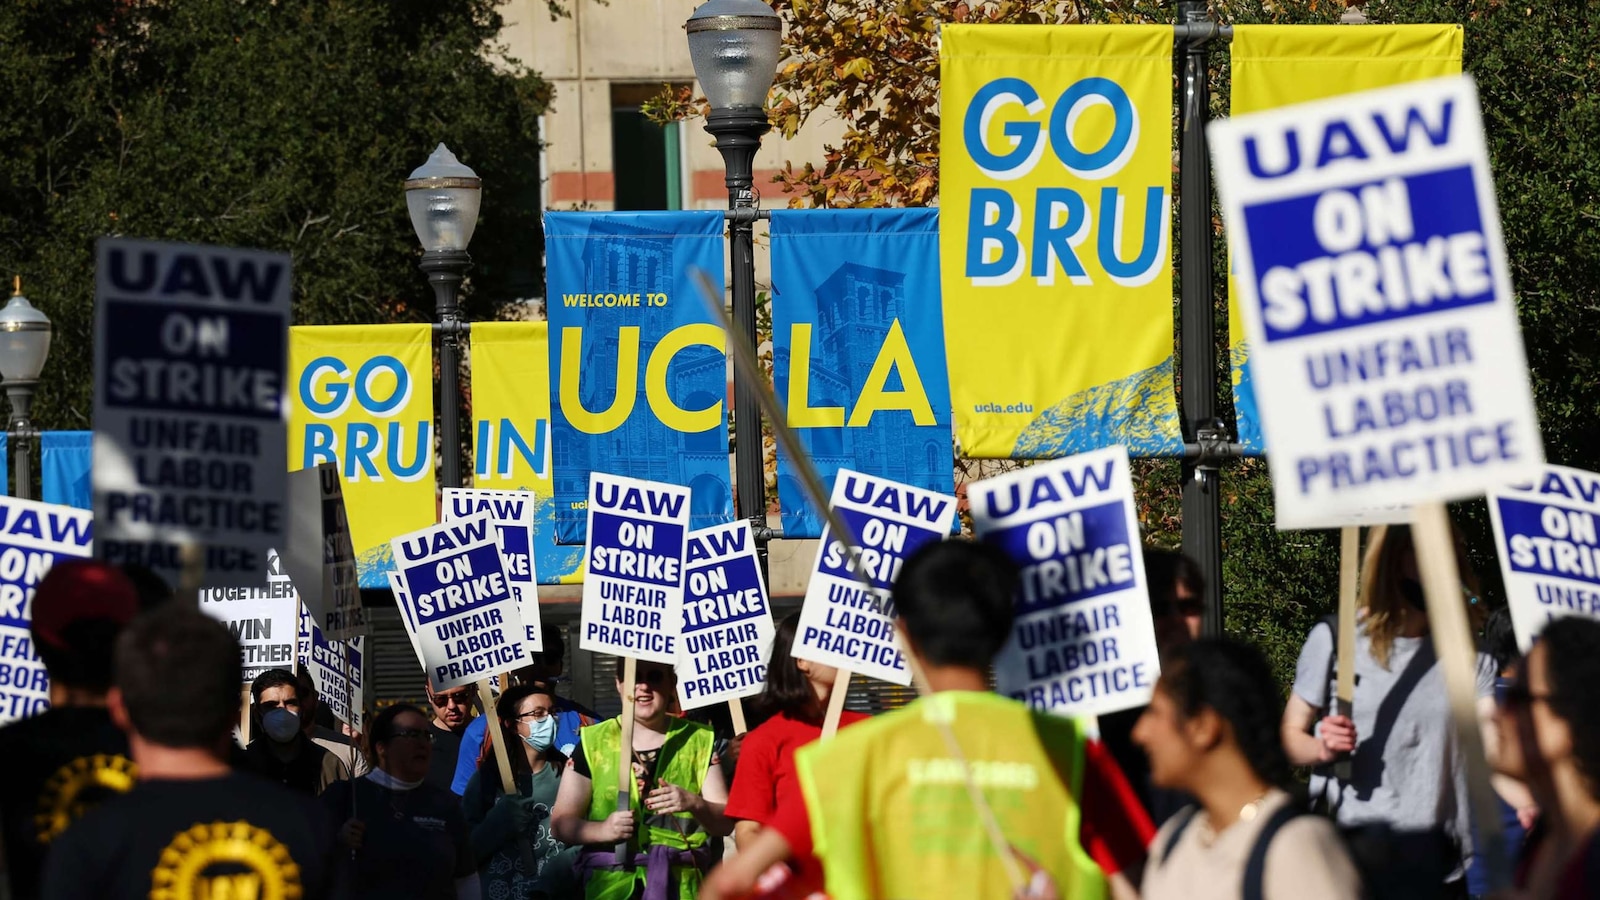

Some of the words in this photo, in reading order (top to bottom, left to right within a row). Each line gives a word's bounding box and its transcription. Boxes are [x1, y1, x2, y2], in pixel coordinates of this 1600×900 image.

[963, 77, 1140, 181] GO
[1242, 97, 1456, 180] UAW
[1312, 178, 1415, 252] ON
[965, 186, 1172, 288] BRU
[107, 248, 283, 304] UAW
[1260, 231, 1493, 332] STRIKE
[562, 293, 641, 309] WELCOME
[646, 292, 668, 307] TO
[161, 314, 229, 357] ON
[1306, 327, 1474, 392] UNFAIR
[110, 357, 281, 412] STRIKE
[299, 355, 413, 420] GO
[974, 402, 1034, 416] ucla.edu
[1323, 380, 1475, 440] LABOR
[129, 417, 260, 457] UNFAIR
[302, 420, 434, 483] BRU
[474, 418, 551, 481] IN
[1296, 420, 1521, 495] PRACTICE
[138, 458, 254, 492] LABOR
[985, 460, 1115, 520] UAW
[1507, 472, 1600, 503] AW
[106, 492, 283, 533] PRACTICE
[595, 482, 685, 518] UAW
[843, 477, 947, 523] UAW
[401, 518, 487, 561] UAW
[617, 521, 654, 550] ON
[686, 526, 746, 564] AW
[862, 517, 908, 553] ON
[1026, 511, 1085, 561] ON
[1541, 506, 1598, 546] ON
[0, 548, 54, 586] ON
[435, 553, 473, 584] ON
[592, 545, 679, 583] STRIKE
[1021, 543, 1134, 603] TRIKE
[1509, 534, 1600, 580] STRI
[202, 581, 294, 603] TOGETHER
[417, 572, 506, 617] STRIKE
[600, 581, 667, 609] UNFAIR
[689, 566, 728, 597] ON
[435, 608, 503, 641] UNFAIR
[602, 604, 661, 630] LABOR
[825, 608, 896, 643] LABOR
[1017, 604, 1121, 650] UNFAIR
[444, 628, 505, 660] LABOR
[587, 623, 675, 654] PRACTICE
[686, 623, 758, 654] UNFAIR
[803, 627, 906, 670] PRACTICE
[1027, 637, 1119, 680] LABOR
[435, 642, 525, 683] PRACTICE
[694, 644, 760, 675] LABOR
[684, 665, 767, 699] PRACTIC
